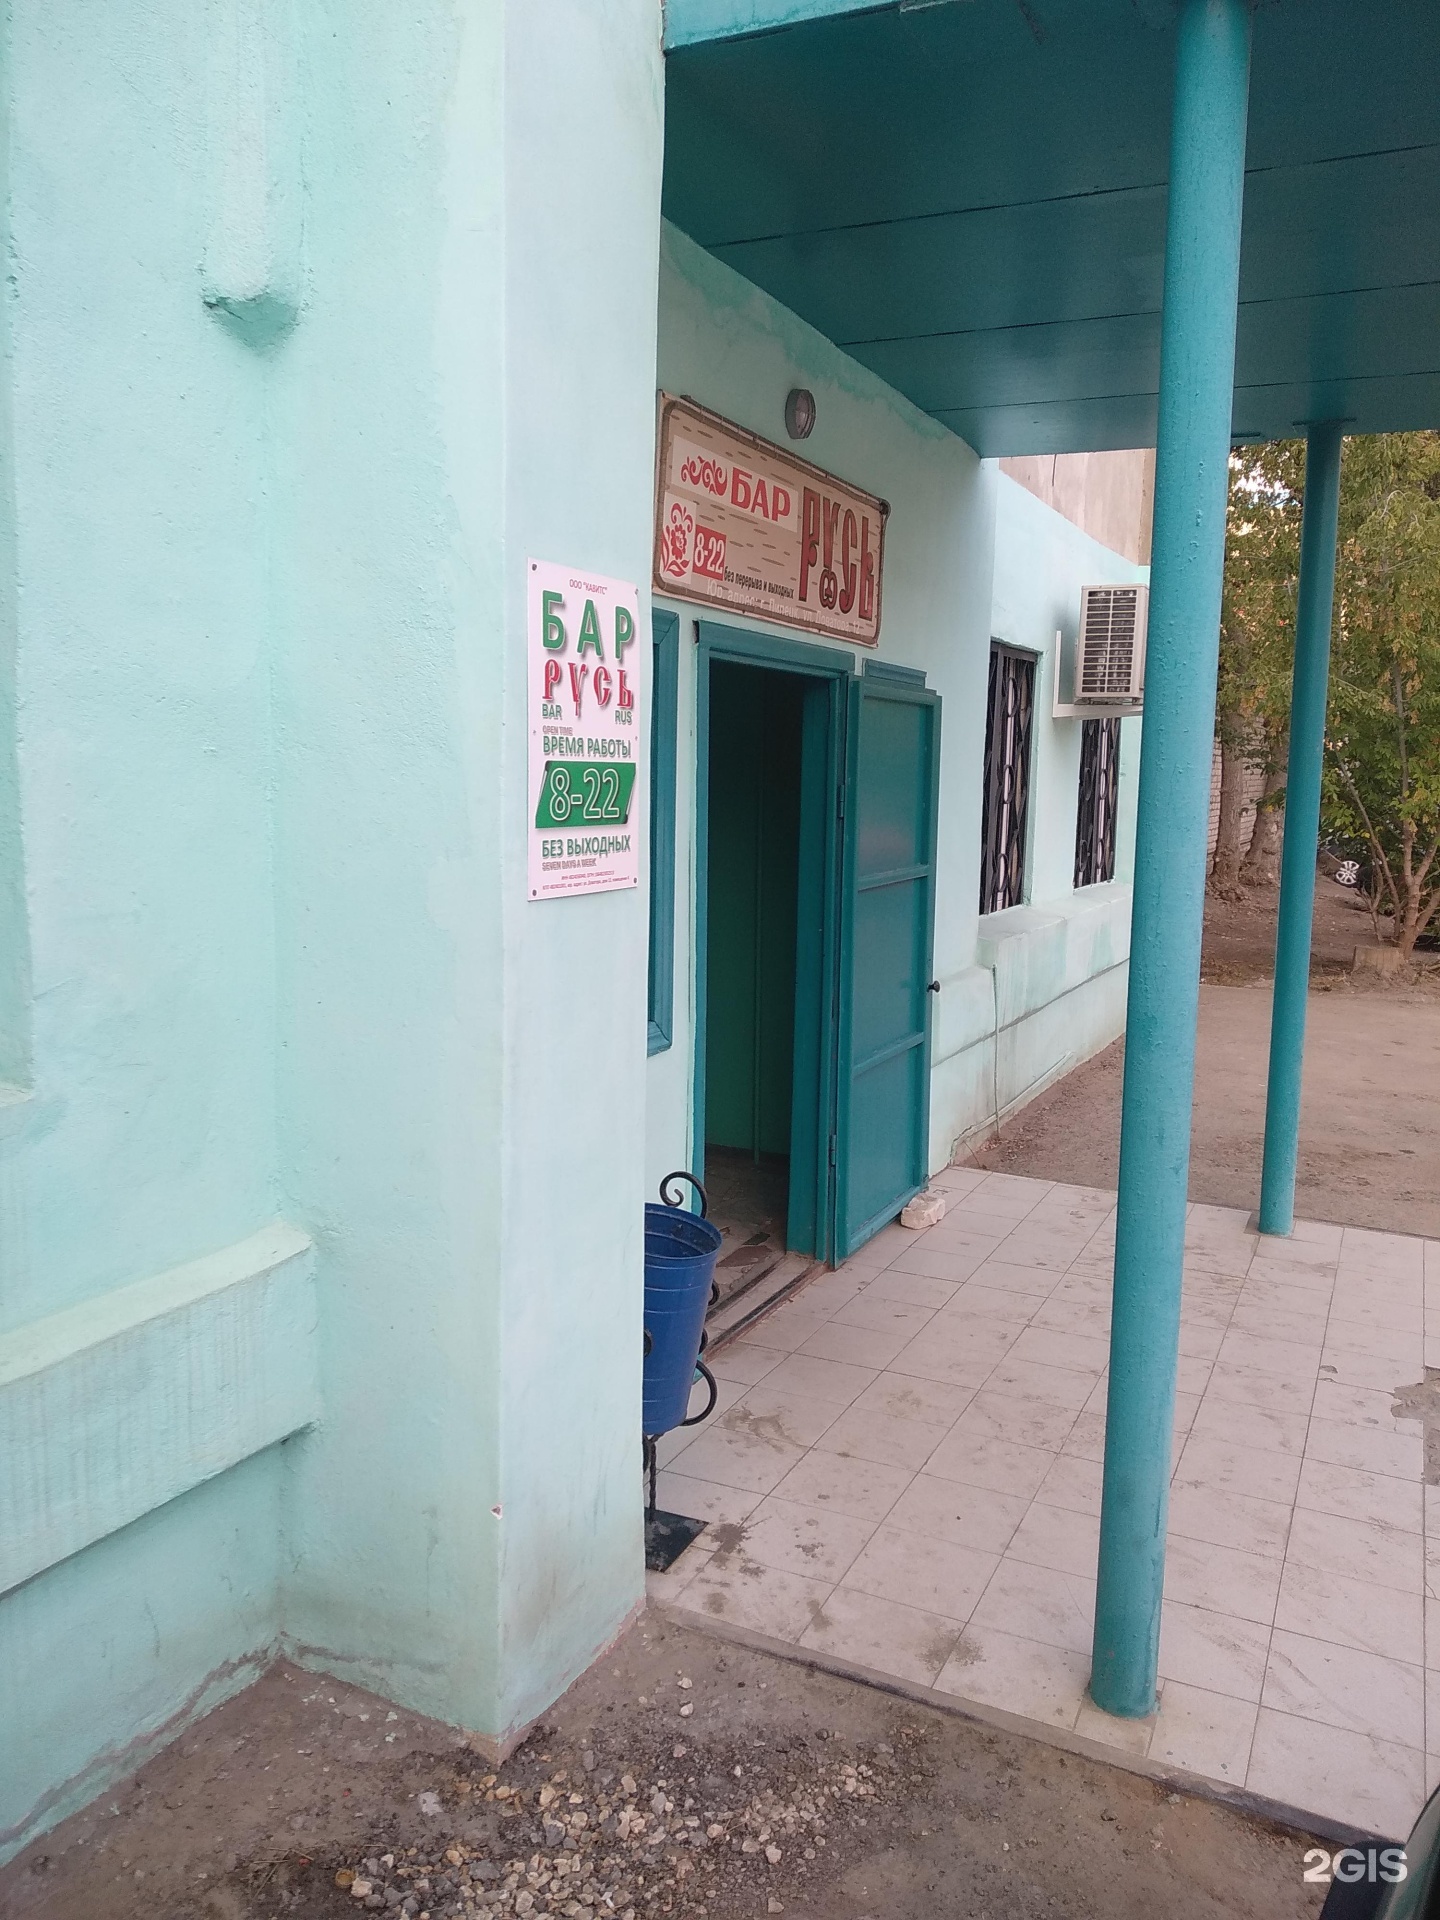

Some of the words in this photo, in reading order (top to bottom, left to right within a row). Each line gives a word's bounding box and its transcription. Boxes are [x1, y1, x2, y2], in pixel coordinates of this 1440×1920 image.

[731, 466, 791, 522] БАР
[694, 532, 726, 575] 8-22
[799, 486, 876, 621] РУСЬ
[569, 579, 583, 589] ООО
[724, 566, 735, 583] без
[735, 572, 763, 591] перерыва
[763, 579, 768, 592] и
[768, 581, 795, 599] выходных
[542, 589, 634, 659] БАР
[542, 658, 633, 717] РУСЬ
[542, 703, 563, 720] BAR
[614, 709, 633, 725] RUS
[542, 725, 559, 736] OPEN
[559, 726, 573, 737] TIME
[543, 735, 584, 756] ВРЕМЯ
[587, 737, 632, 758] РАБОТЫ
[549, 767, 620, 821] 8-22
[542, 838, 564, 859] БЕЗ
[567, 834, 631, 858] ВЫХОДНЫХ
[542, 861, 561, 871] SEVEN
[562, 860, 576, 869] DAYS
[581, 858, 597, 868] WEEK
